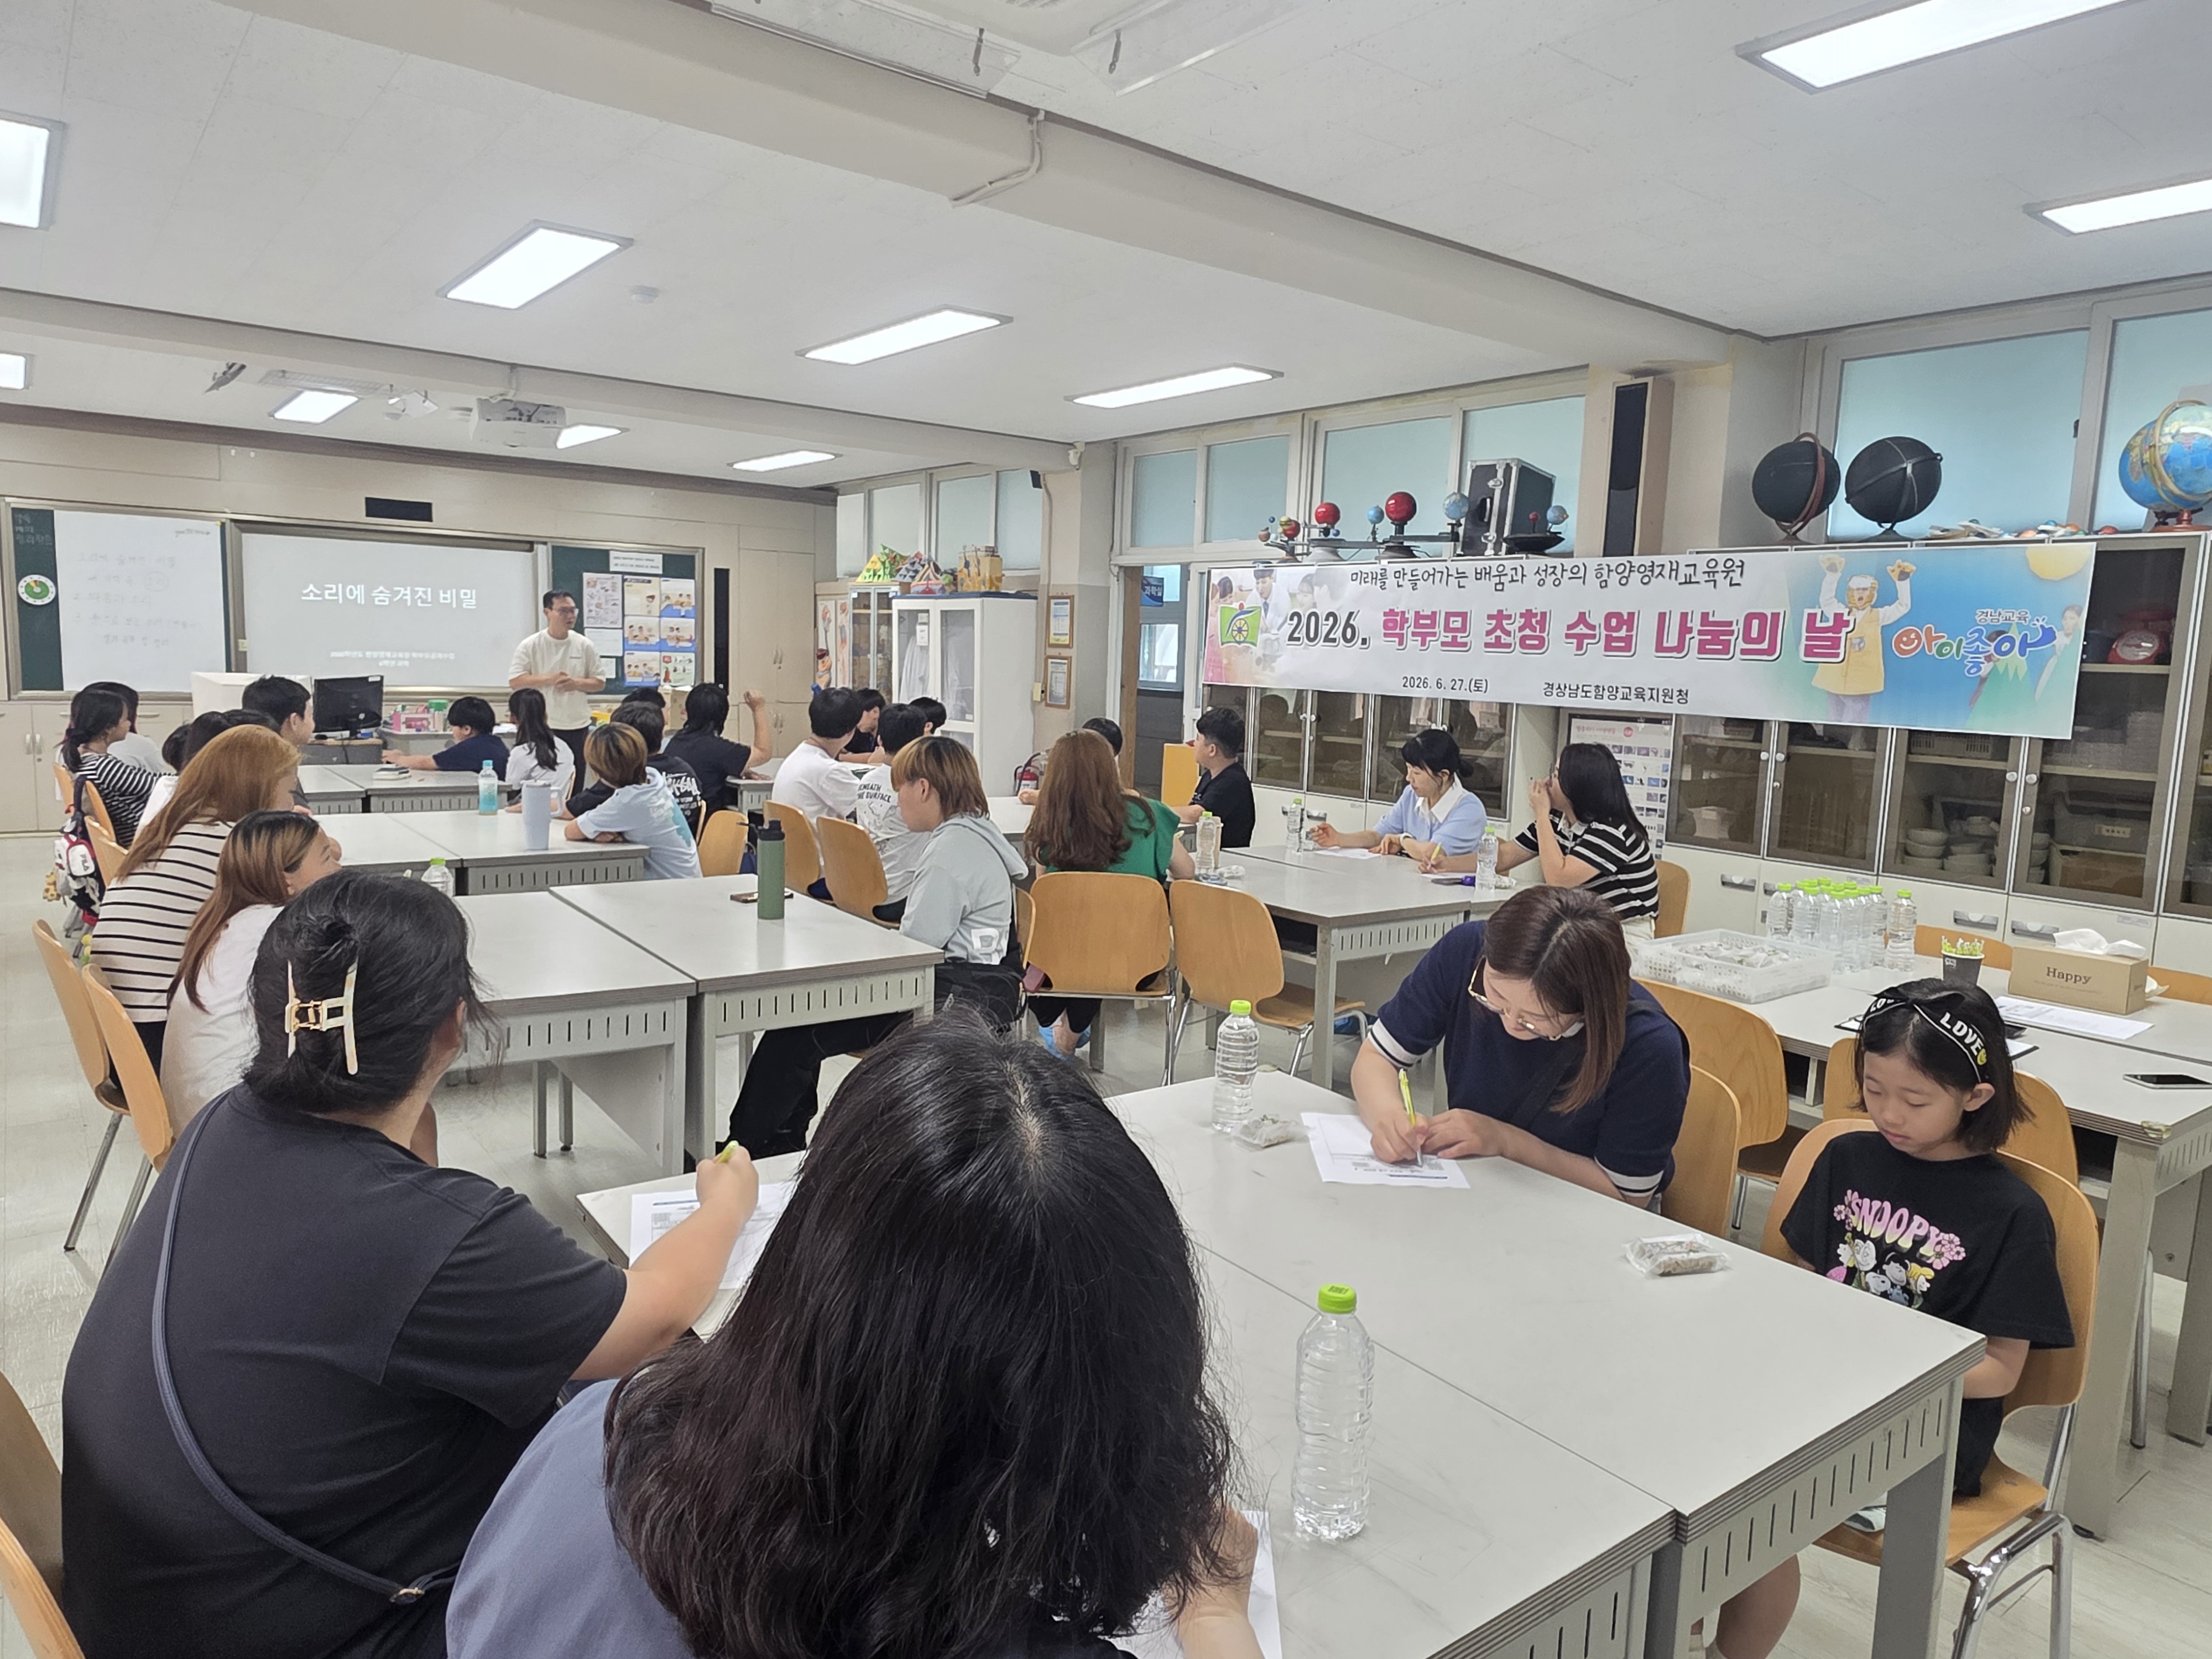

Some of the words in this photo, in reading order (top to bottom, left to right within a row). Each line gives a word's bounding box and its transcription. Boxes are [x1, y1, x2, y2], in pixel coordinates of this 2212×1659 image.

[1350, 570, 1389, 591] 미래를
[1393, 566, 1469, 591] 만들어가는
[1474, 563, 1527, 593] 배움과
[1533, 561, 1588, 588] 성장의
[1594, 557, 1745, 589] 함양영재교육원
[301, 583, 366, 605] 소리에
[371, 585, 433, 607] 숨겨진
[439, 588, 477, 609] 비밀
[1977, 610, 2030, 624] 경남교육
[1286, 610, 1370, 649] 2026.
[1382, 608, 1471, 650] 학부모
[1484, 608, 1549, 653] 초청
[1564, 611, 1636, 655] 수업
[1654, 611, 1783, 658] 나눔의
[1803, 611, 1851, 660] 날
[1893, 624, 2058, 676] 아이좋아
[1402, 676, 1432, 690] 2026.
[1436, 679, 1447, 690] 6.
[1450, 679, 1489, 694] 27.(토)
[1542, 682, 1689, 705] 경상남도함양교육지원청
[865, 792, 892, 804] SURFACE
[80, 853, 90, 872] FILA
[2046, 966, 2093, 985] Happy
[1870, 998, 1901, 1013] LO
[1939, 1011, 1985, 1056] LOVE
[1850, 1197, 1945, 1257] SNOOPY
